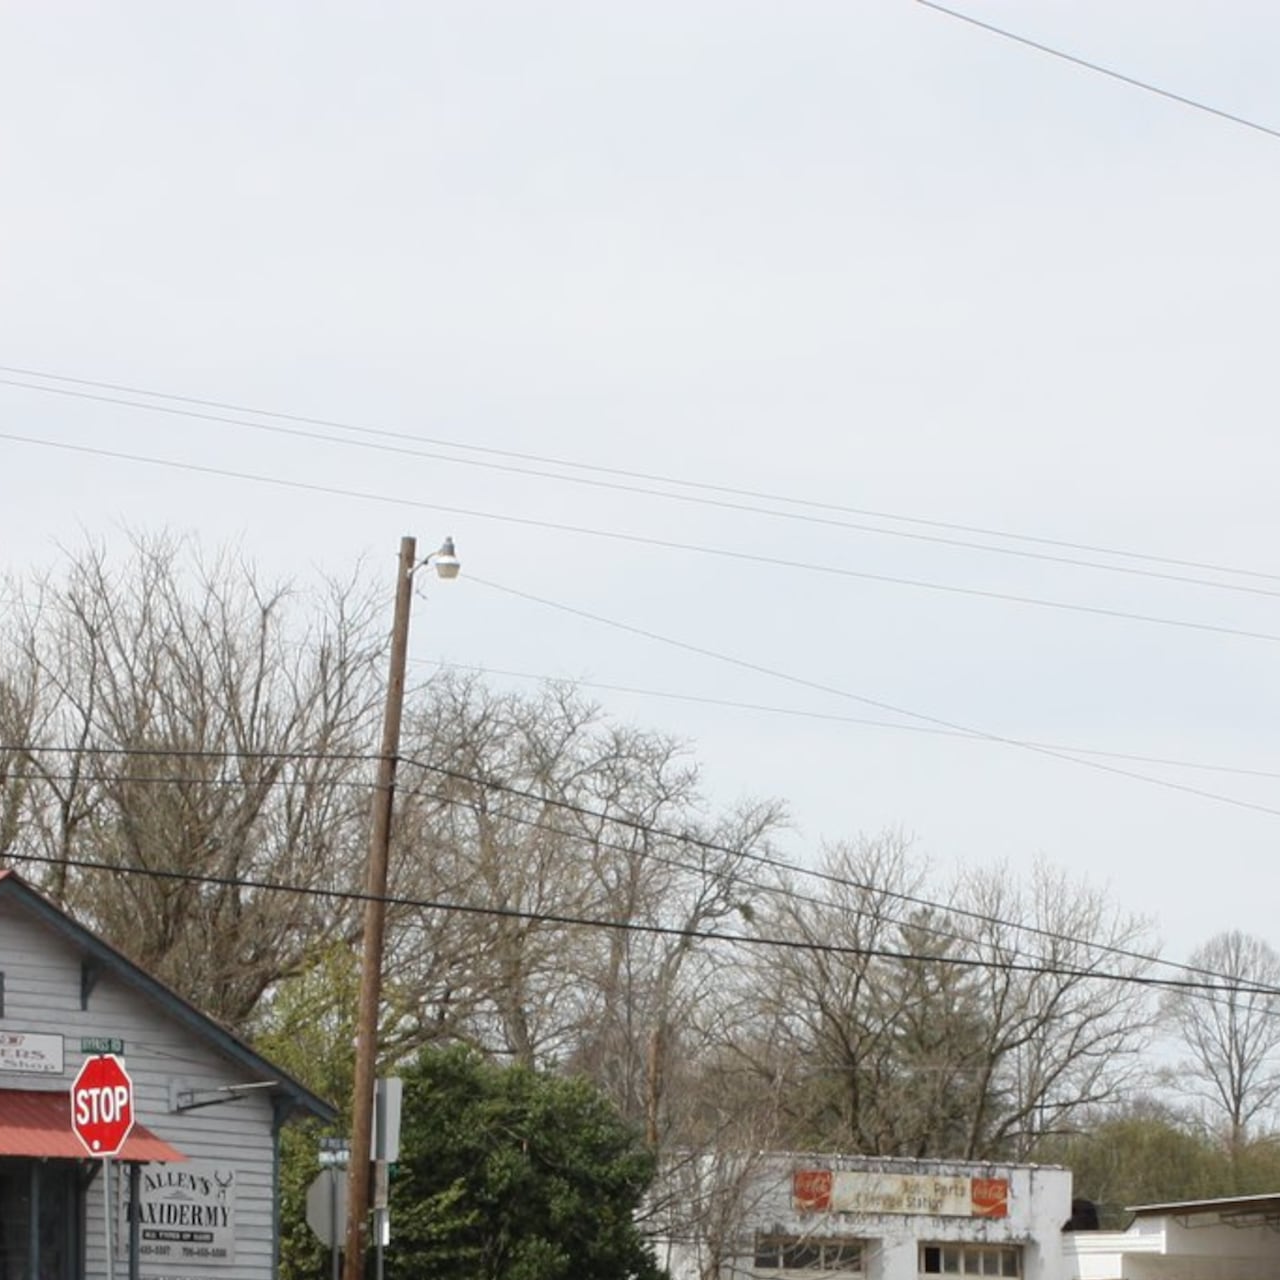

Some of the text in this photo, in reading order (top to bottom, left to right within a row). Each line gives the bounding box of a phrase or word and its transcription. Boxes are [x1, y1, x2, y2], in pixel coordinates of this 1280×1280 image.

[3, 1058, 56, 1071] Shop
[76, 1086, 129, 1125] STOP
[145, 1171, 212, 1196] ALLEN'S
